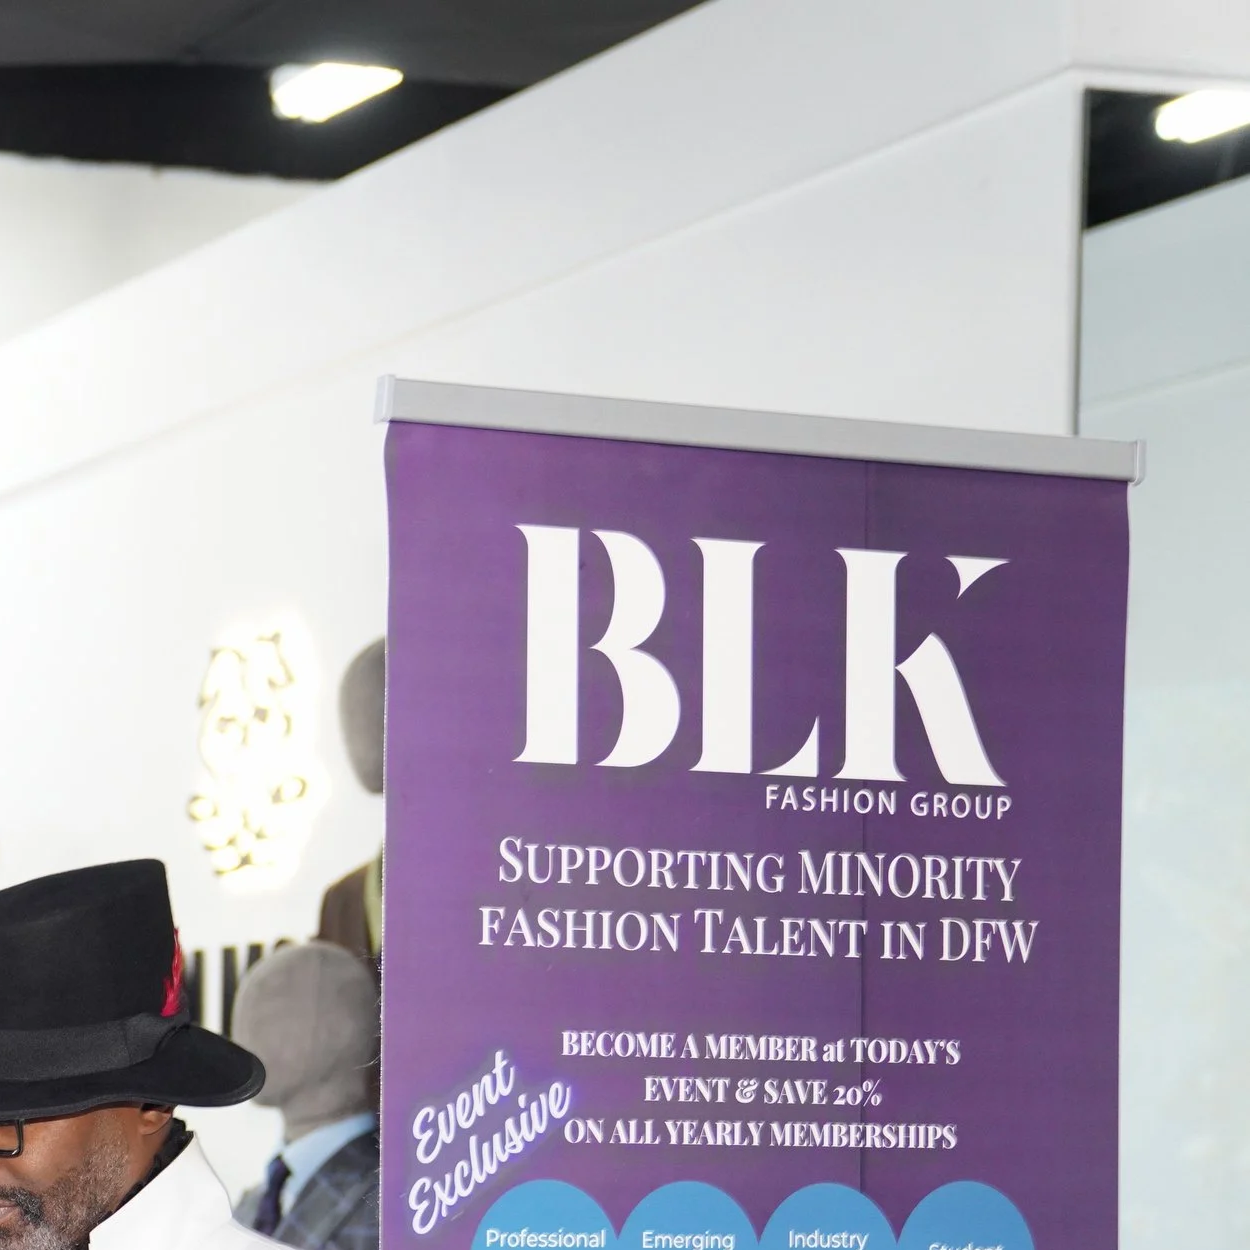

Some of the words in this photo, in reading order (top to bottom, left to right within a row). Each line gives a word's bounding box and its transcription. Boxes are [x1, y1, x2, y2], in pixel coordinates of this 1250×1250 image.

[512, 523, 1010, 787] BLK
[766, 784, 896, 815] FASHION
[910, 792, 1011, 820] GROUP
[499, 836, 785, 893] SUPPORTING
[797, 850, 1021, 902] MINORITY
[478, 906, 681, 952] FASHION
[693, 908, 868, 958] TALENT
[880, 921, 926, 961] IN
[939, 918, 1039, 964] DFW
[561, 1031, 675, 1058] BECOME
[680, 1034, 699, 1059] A
[704, 1034, 817, 1062] MEMBER
[822, 1039, 845, 1063] at
[850, 1037, 961, 1065] TODAY'S
[412, 1049, 514, 1164] Event
[644, 1076, 730, 1103] EVENT
[735, 1078, 759, 1104] &
[763, 1079, 827, 1105] SAVE
[832, 1079, 882, 1107] 20%
[563, 1118, 604, 1144] ON
[609, 1119, 661, 1145] ALL
[664, 1119, 764, 1146] YEARLY
[769, 1122, 957, 1150] MEMBERSHIPS
[408, 1081, 571, 1235] Exclusive
[486, 1228, 606, 1248] Professional
